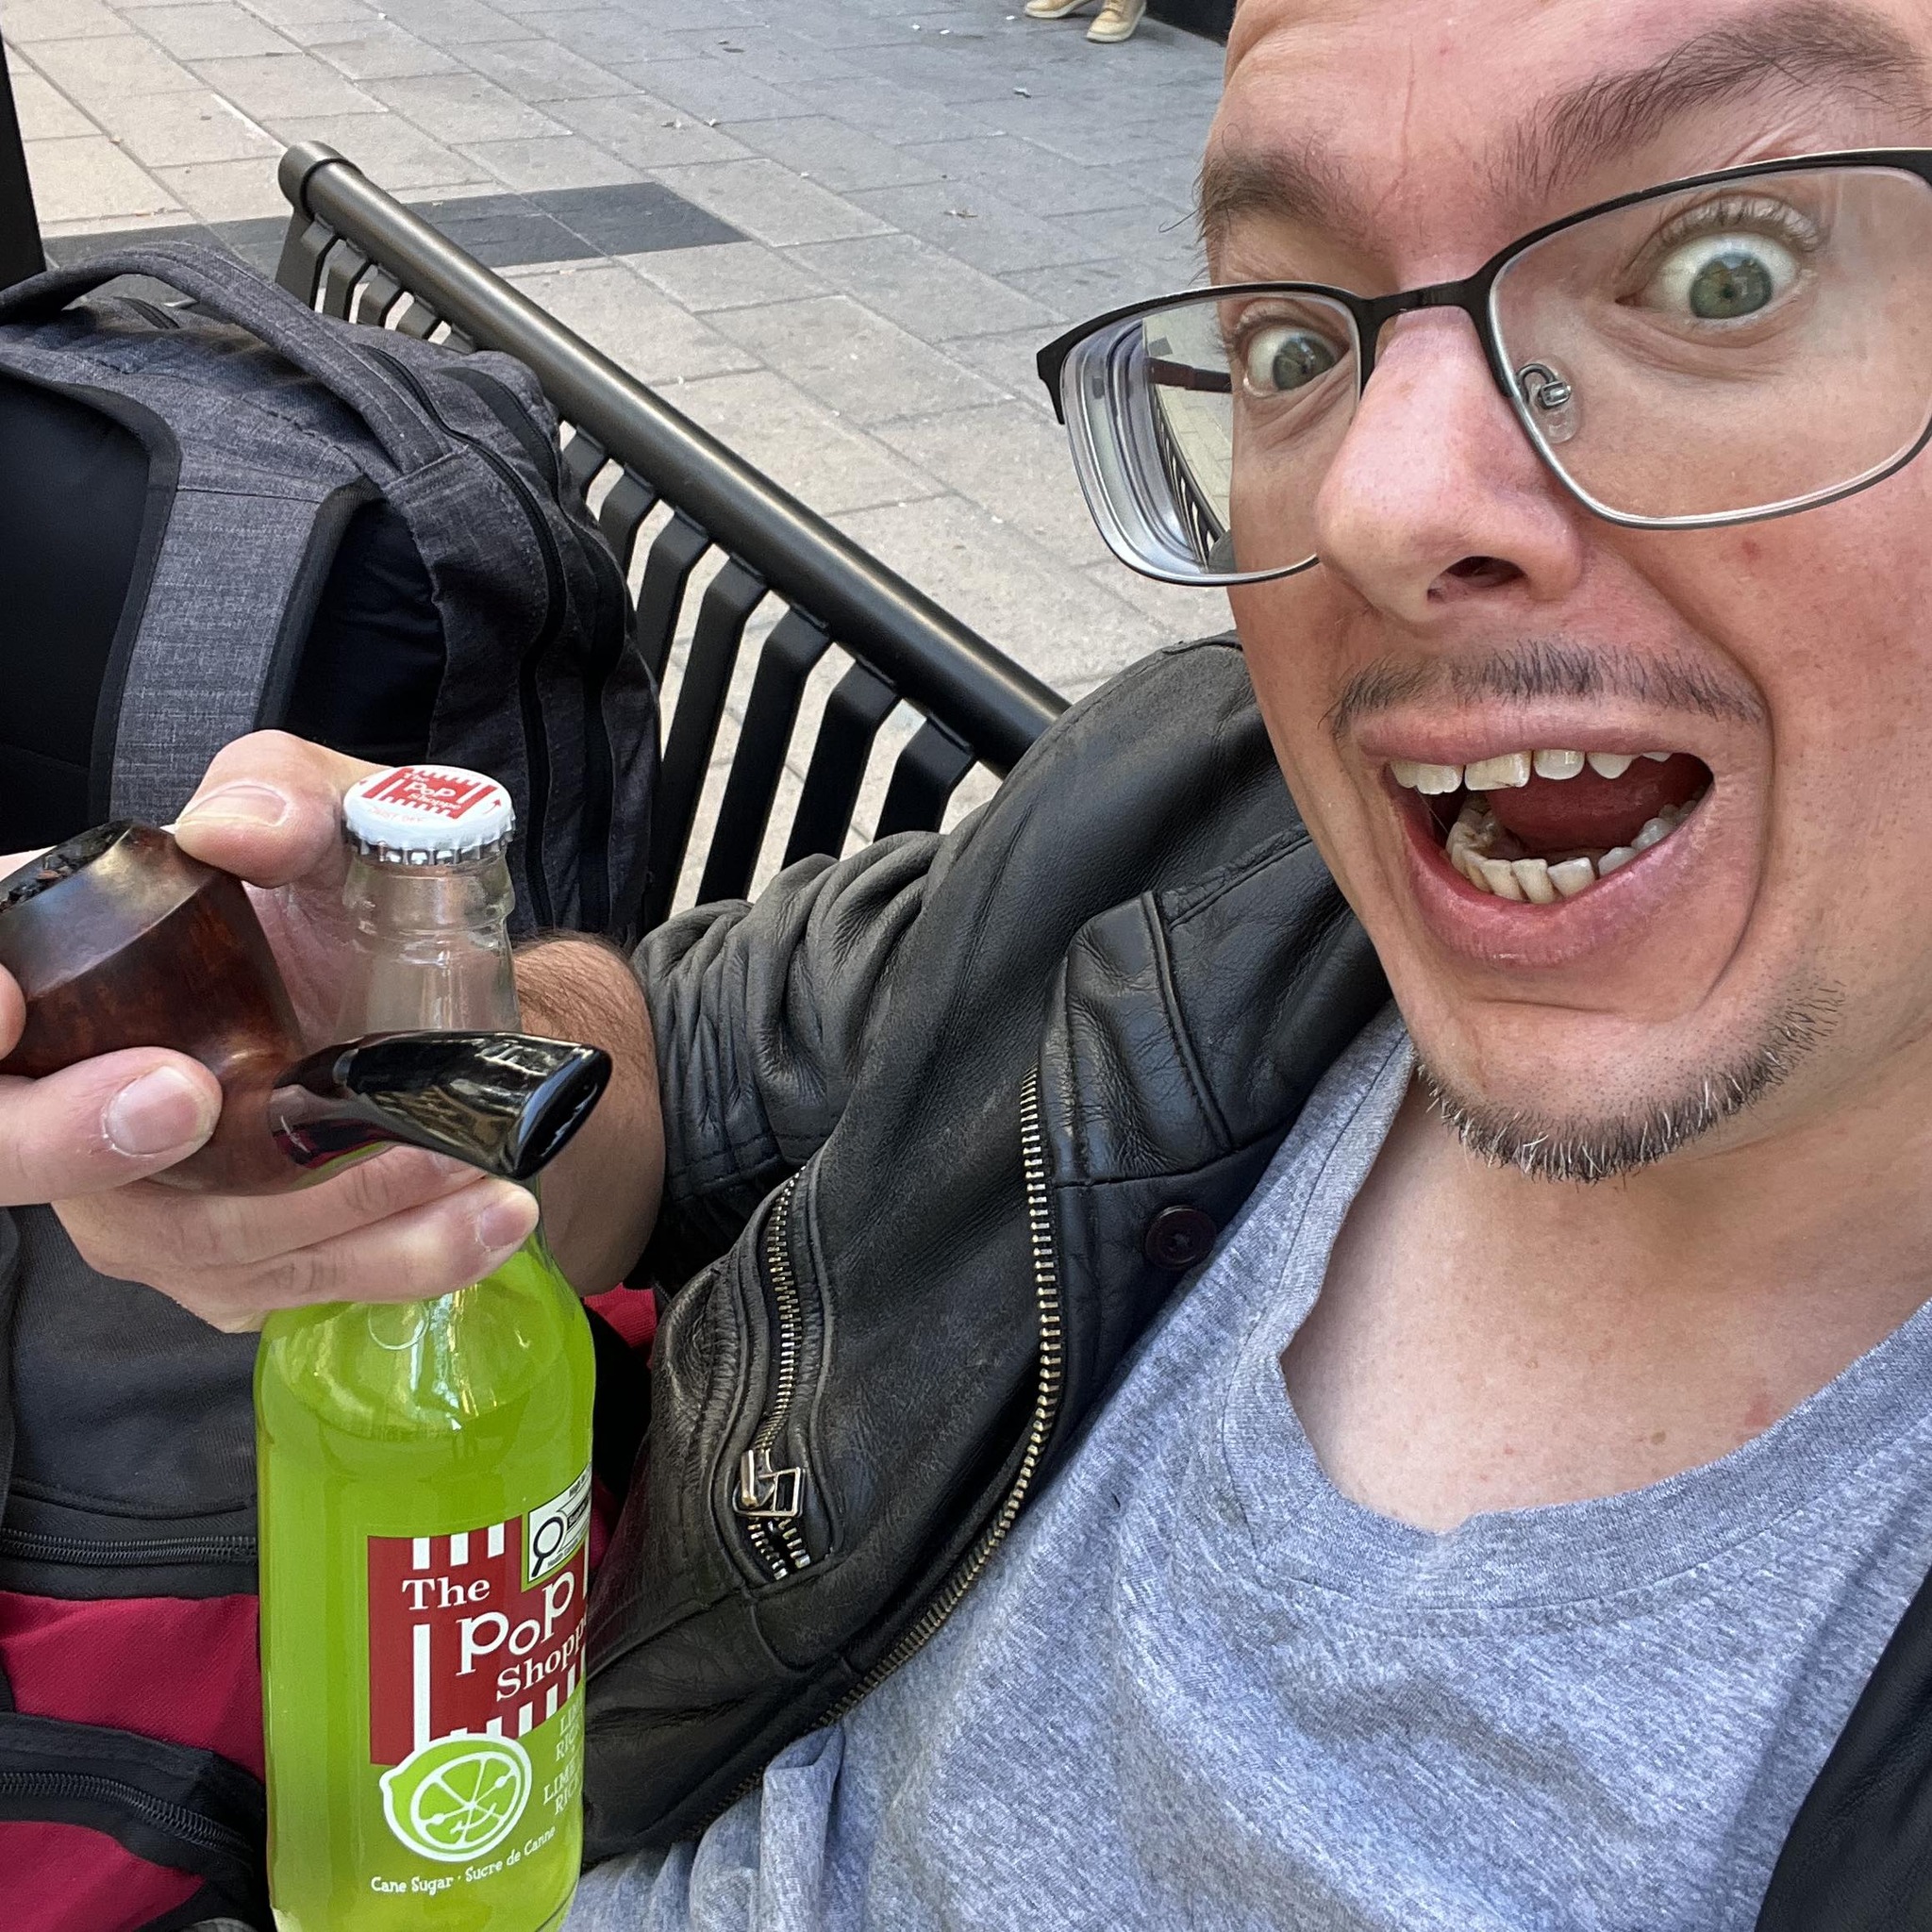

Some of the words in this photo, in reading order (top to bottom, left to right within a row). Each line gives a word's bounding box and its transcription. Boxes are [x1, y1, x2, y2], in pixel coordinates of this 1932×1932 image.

[402, 1575, 491, 1611] The
[496, 1615, 587, 1703] Shopp
[371, 1875, 408, 1893] Cane
[411, 1875, 455, 1896] Sugar
[465, 1865, 504, 1883] Sucre
[506, 1848, 522, 1867] de
[523, 1825, 557, 1857] Canne
